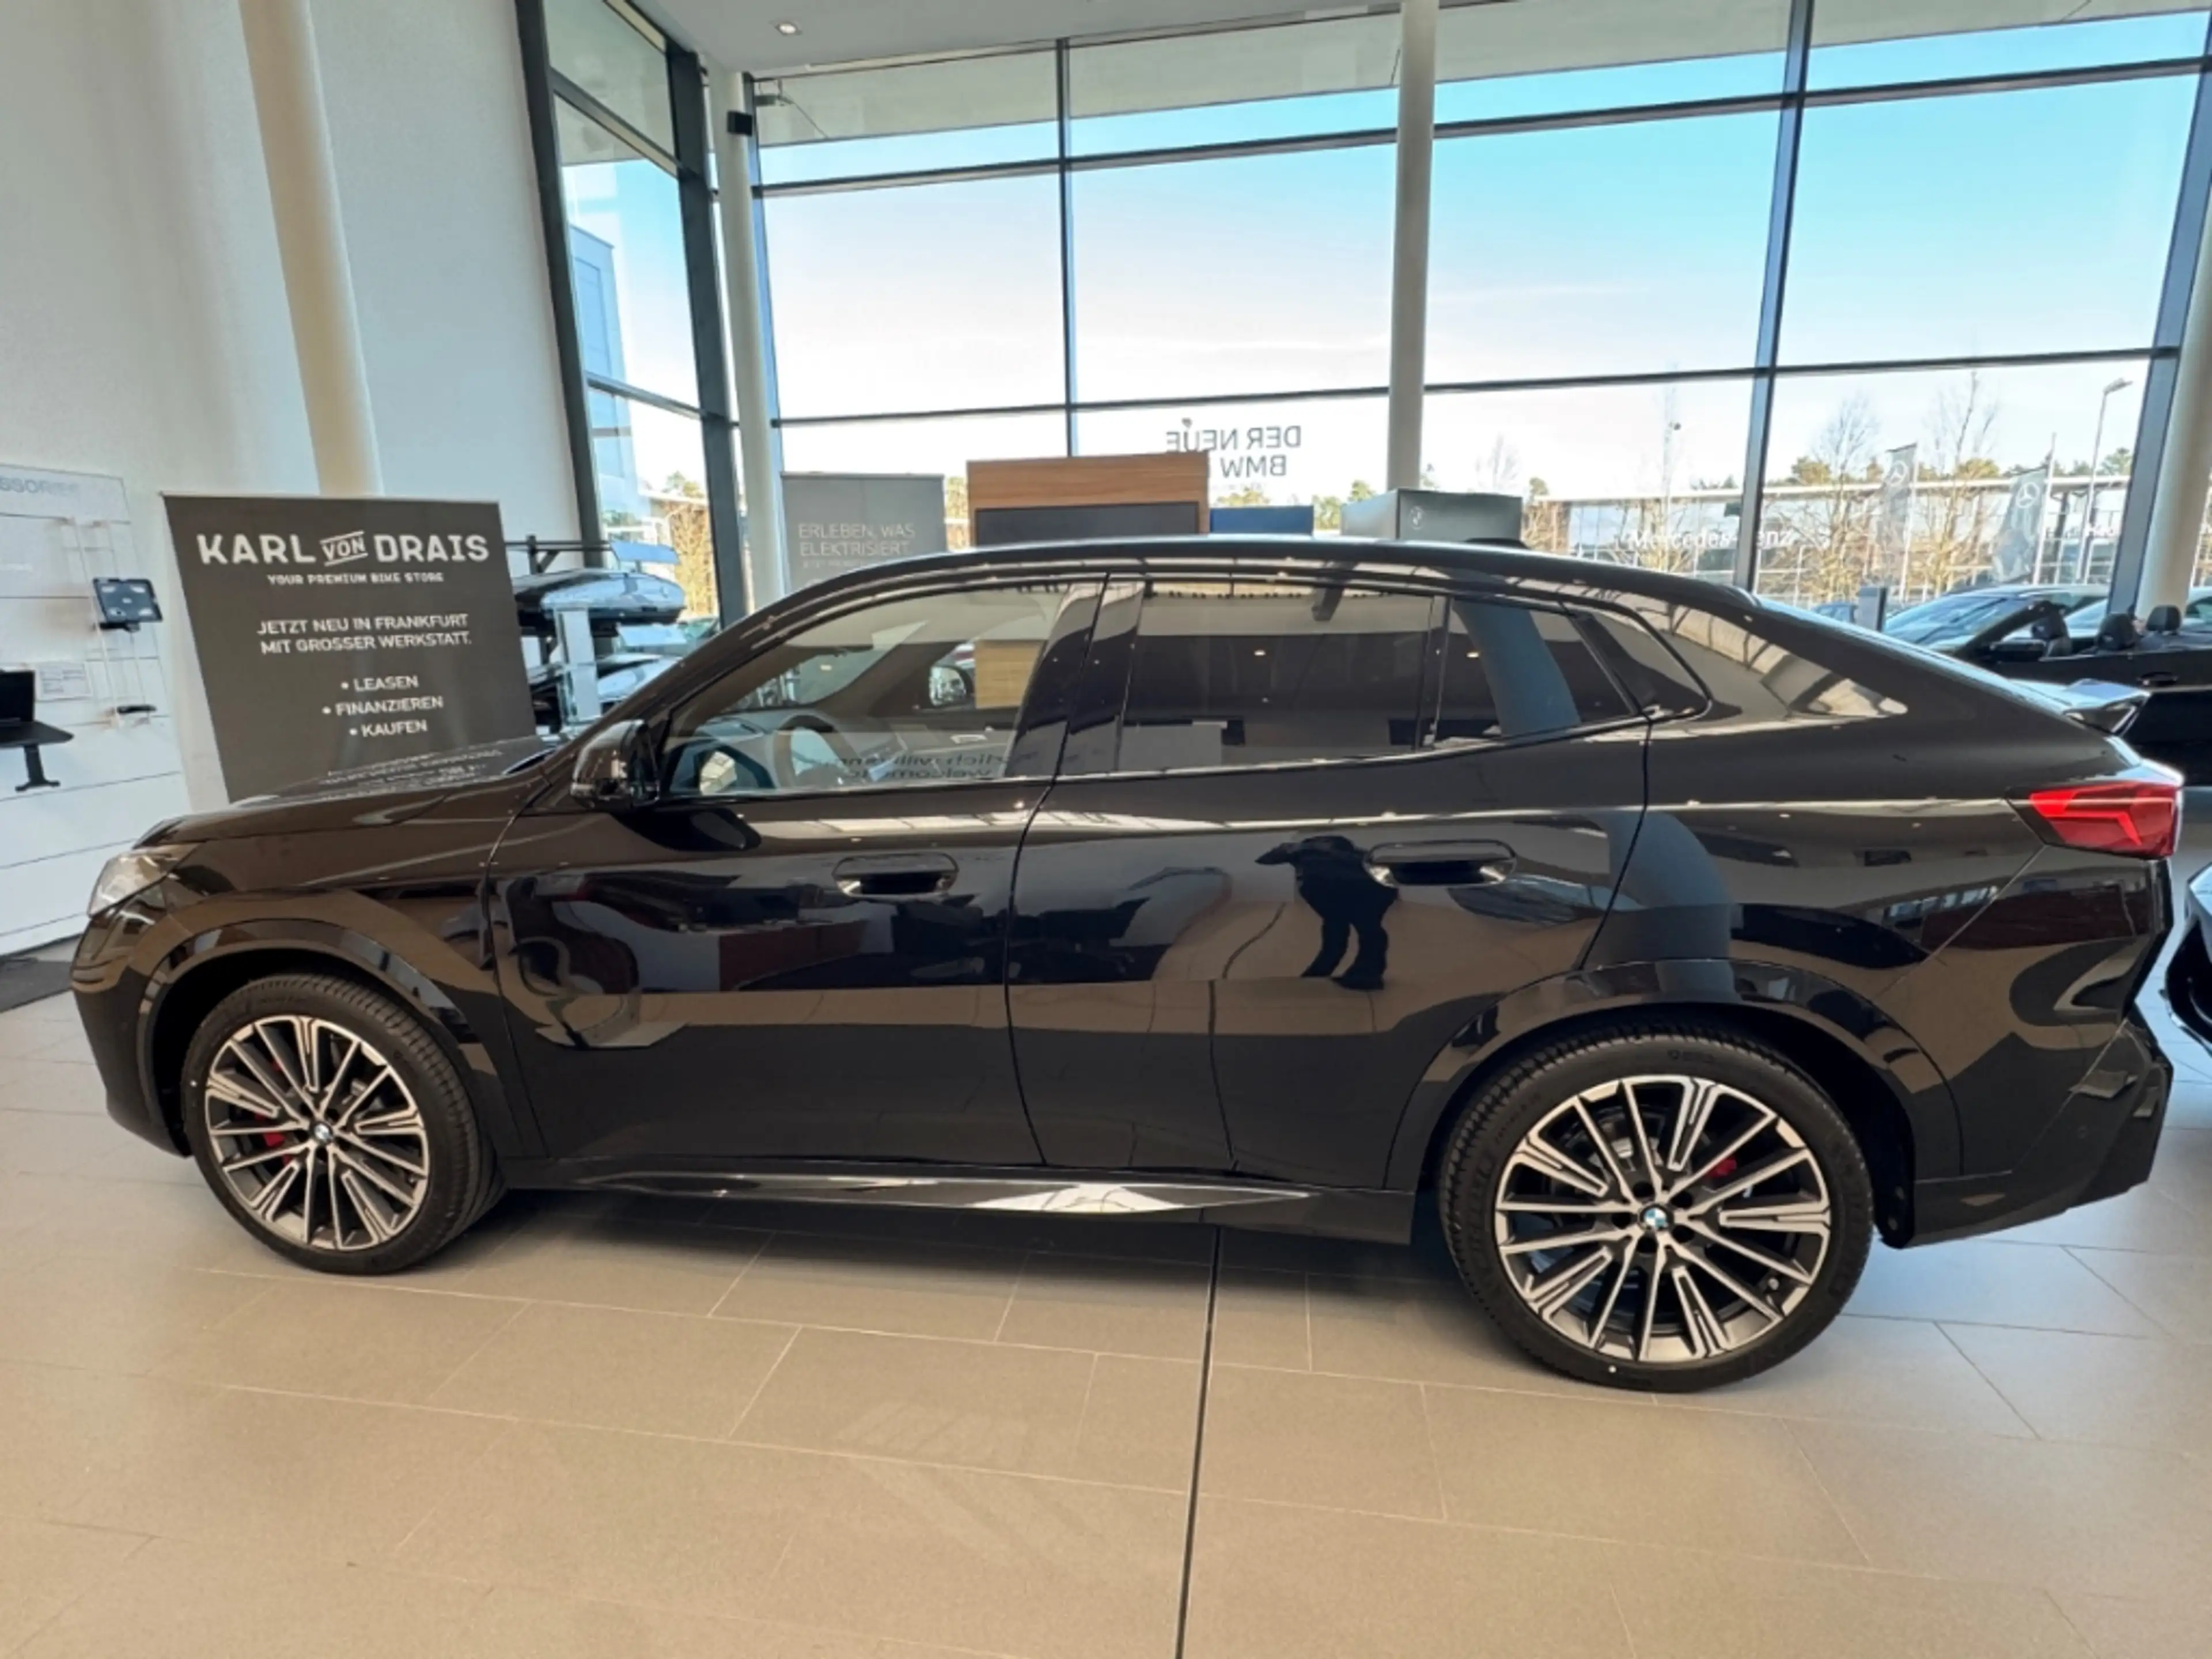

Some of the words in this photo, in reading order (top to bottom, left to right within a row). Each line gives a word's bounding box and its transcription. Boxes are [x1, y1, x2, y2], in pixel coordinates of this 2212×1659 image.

[881, 522, 916, 539] WAS
[1628, 528, 1794, 549] Mercedes-enz
[196, 533, 316, 565] KARL
[323, 536, 367, 560] VON
[374, 534, 490, 565] DRAIS
[267, 573, 304, 586] YOUR
[308, 573, 368, 584] PREMIUM
[371, 572, 402, 583] BIKE
[404, 571, 445, 583] STORE
[257, 619, 308, 635] JETZT
[312, 617, 348, 632] NEU
[352, 617, 371, 631] IN
[375, 613, 468, 630] FRANKFURT
[260, 638, 291, 655] MIT
[296, 635, 377, 652] GROSSER
[378, 630, 472, 649] WERKSTATT.
[353, 675, 420, 692] LEASEN
[334, 695, 444, 716] FINANZIEREN
[361, 719, 428, 737] KAUFEN
